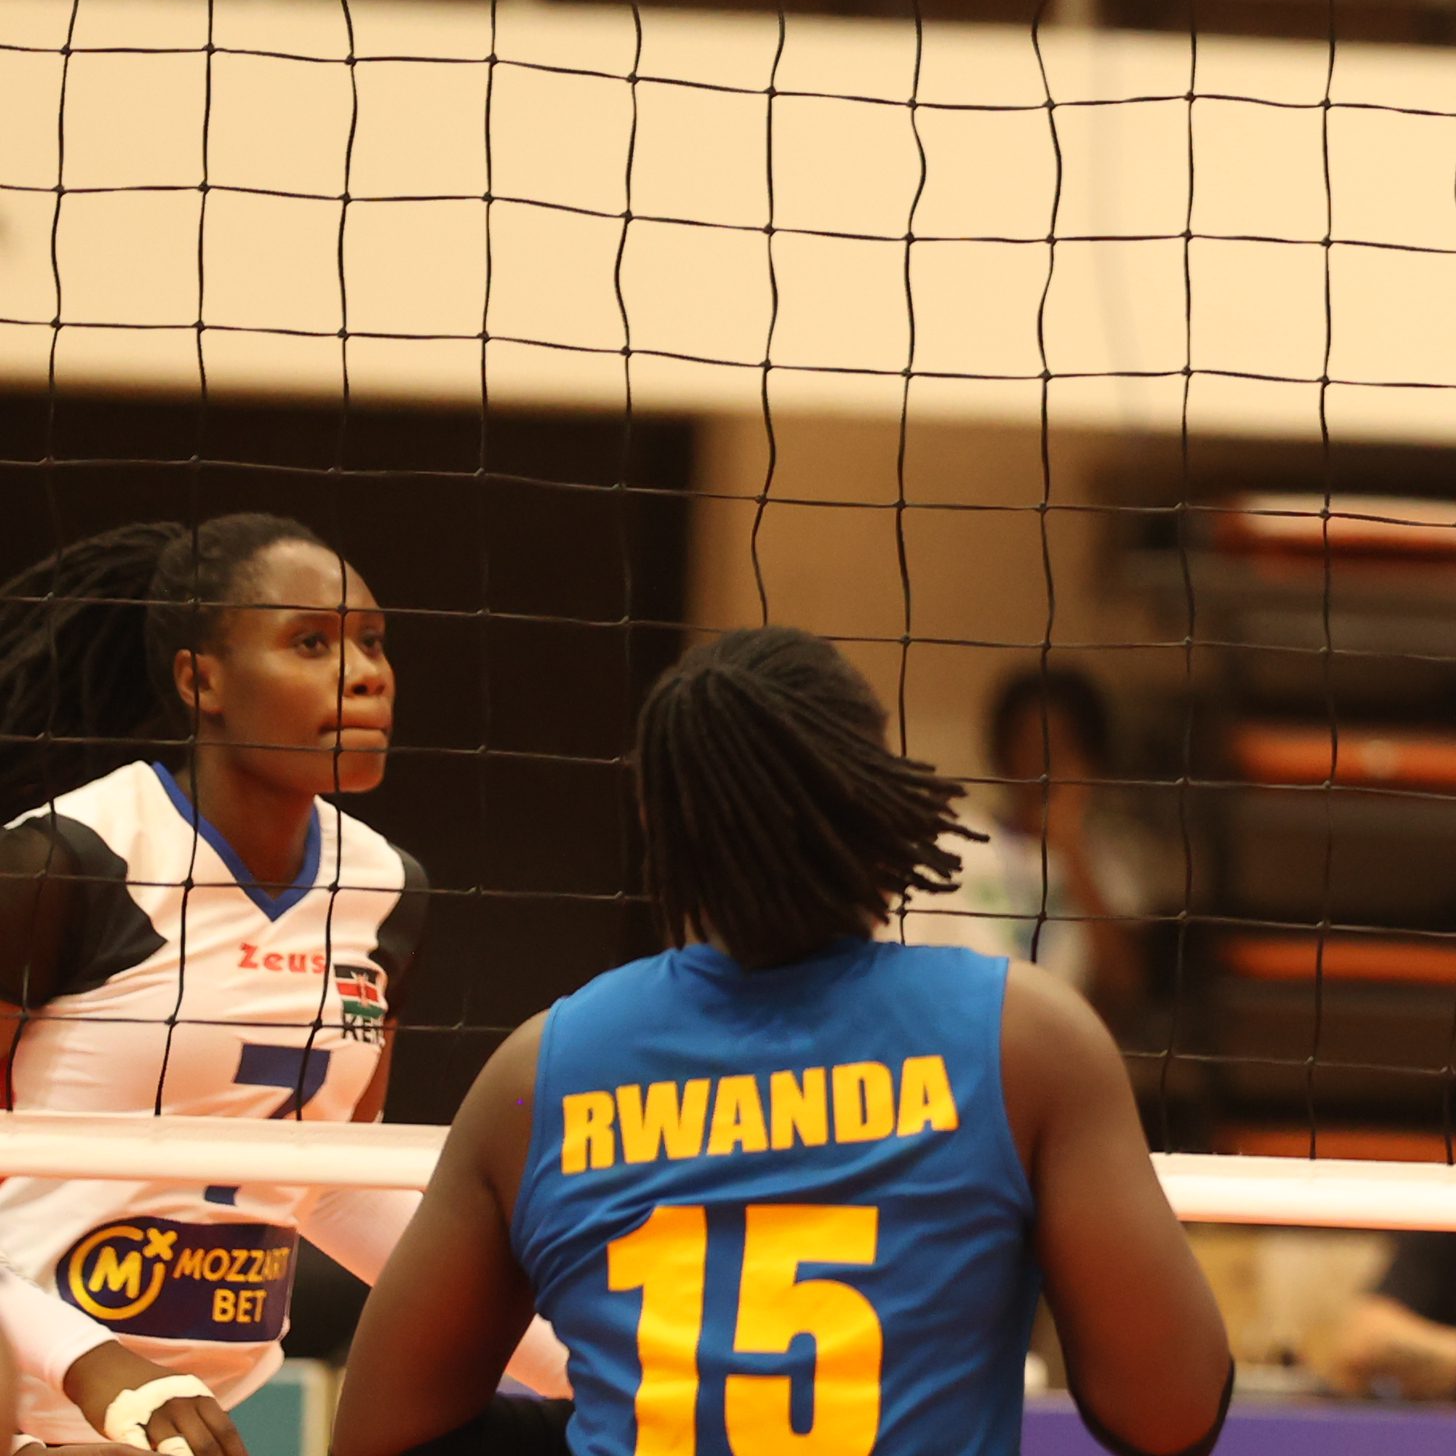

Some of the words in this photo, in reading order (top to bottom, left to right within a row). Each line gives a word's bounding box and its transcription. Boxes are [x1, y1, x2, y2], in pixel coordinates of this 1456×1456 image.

[239, 943, 326, 975] Zeus
[561, 1055, 959, 1176] RWANDA
[212, 1289, 267, 1323] BET
[606, 1204, 884, 1456] 15
